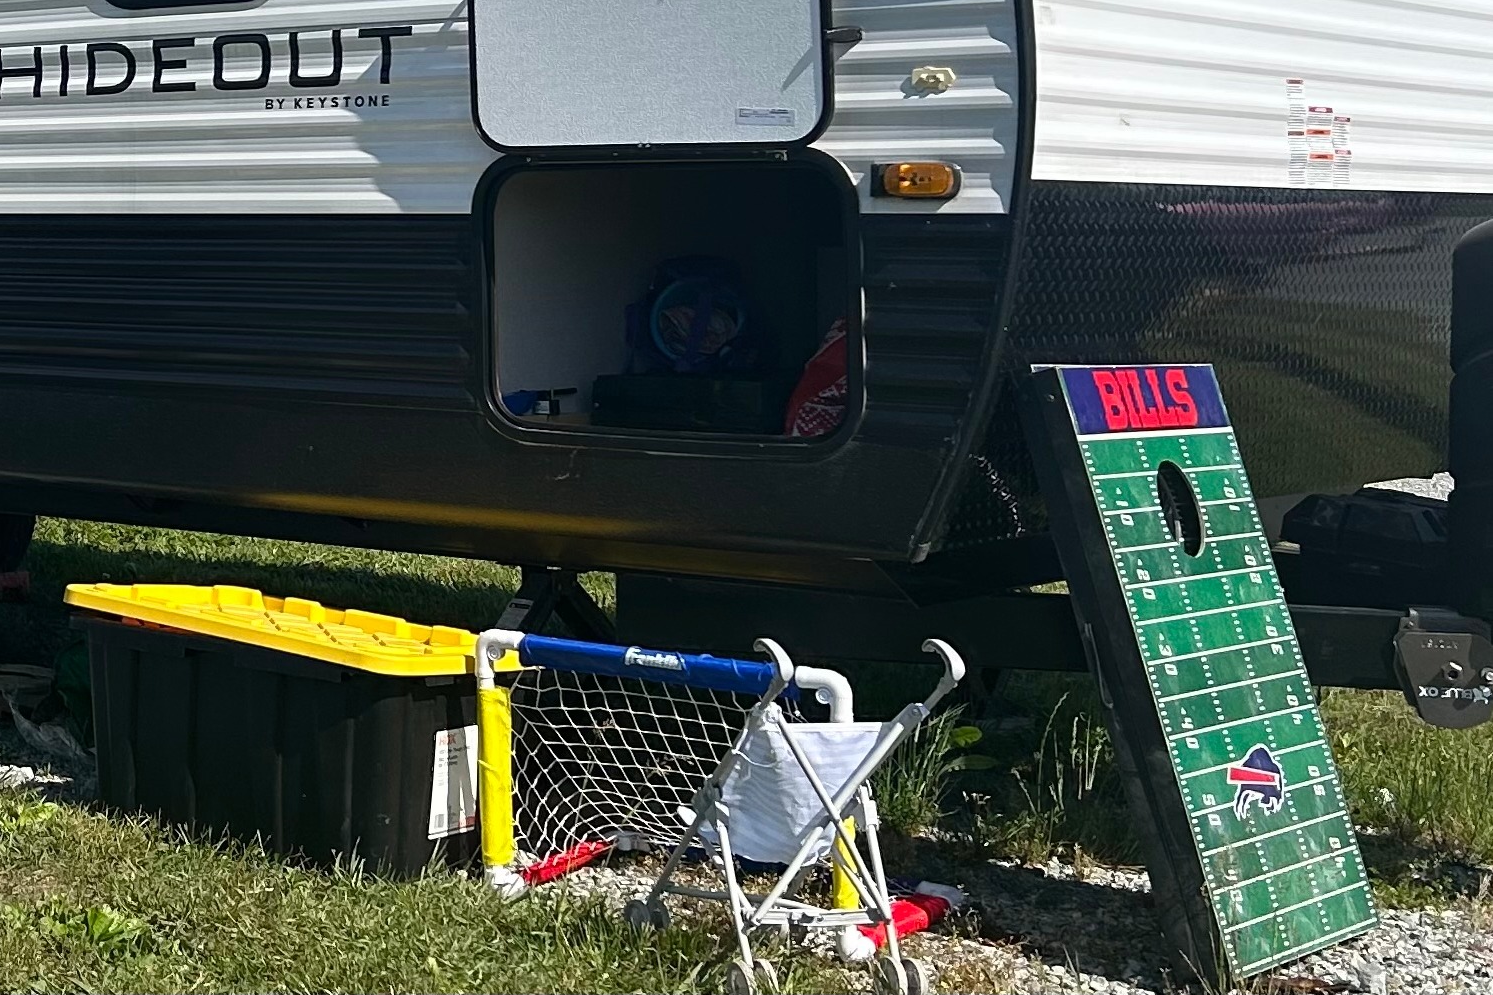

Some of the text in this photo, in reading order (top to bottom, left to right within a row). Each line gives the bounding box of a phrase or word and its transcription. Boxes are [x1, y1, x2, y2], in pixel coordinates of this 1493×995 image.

[265, 95, 390, 110] BY KEYSTONE
[1092, 368, 1199, 431] BILLS
